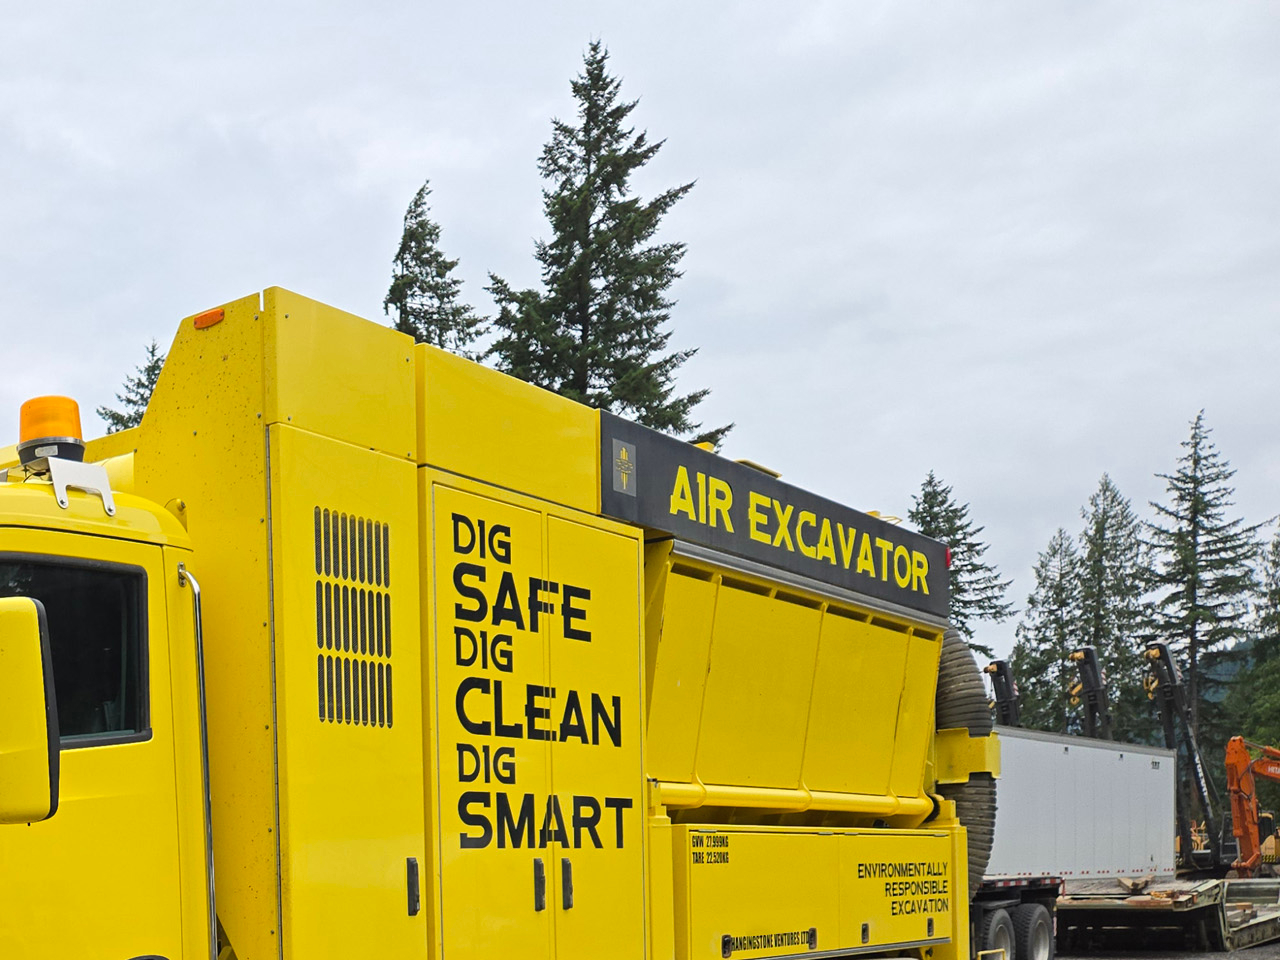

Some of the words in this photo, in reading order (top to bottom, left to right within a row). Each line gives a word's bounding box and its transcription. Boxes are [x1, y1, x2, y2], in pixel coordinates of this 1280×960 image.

[452, 512, 512, 564] DIG
[670, 465, 734, 533] AIR
[748, 491, 930, 595] EXCAVATOR
[453, 563, 592, 642] SAFE
[454, 626, 514, 673] DIG
[456, 676, 622, 748] CLEAN
[457, 743, 516, 785] DIG
[458, 791, 633, 849] SMART
[692, 852, 705, 864] TARE
[858, 862, 948, 879] ENVIRONMENTALLY
[885, 880, 948, 897] RESPONSIBLE
[891, 898, 949, 916] EXCAVATION
[731, 934, 774, 951] HANGINGSTONE
[774, 931, 800, 947] VENTURES
